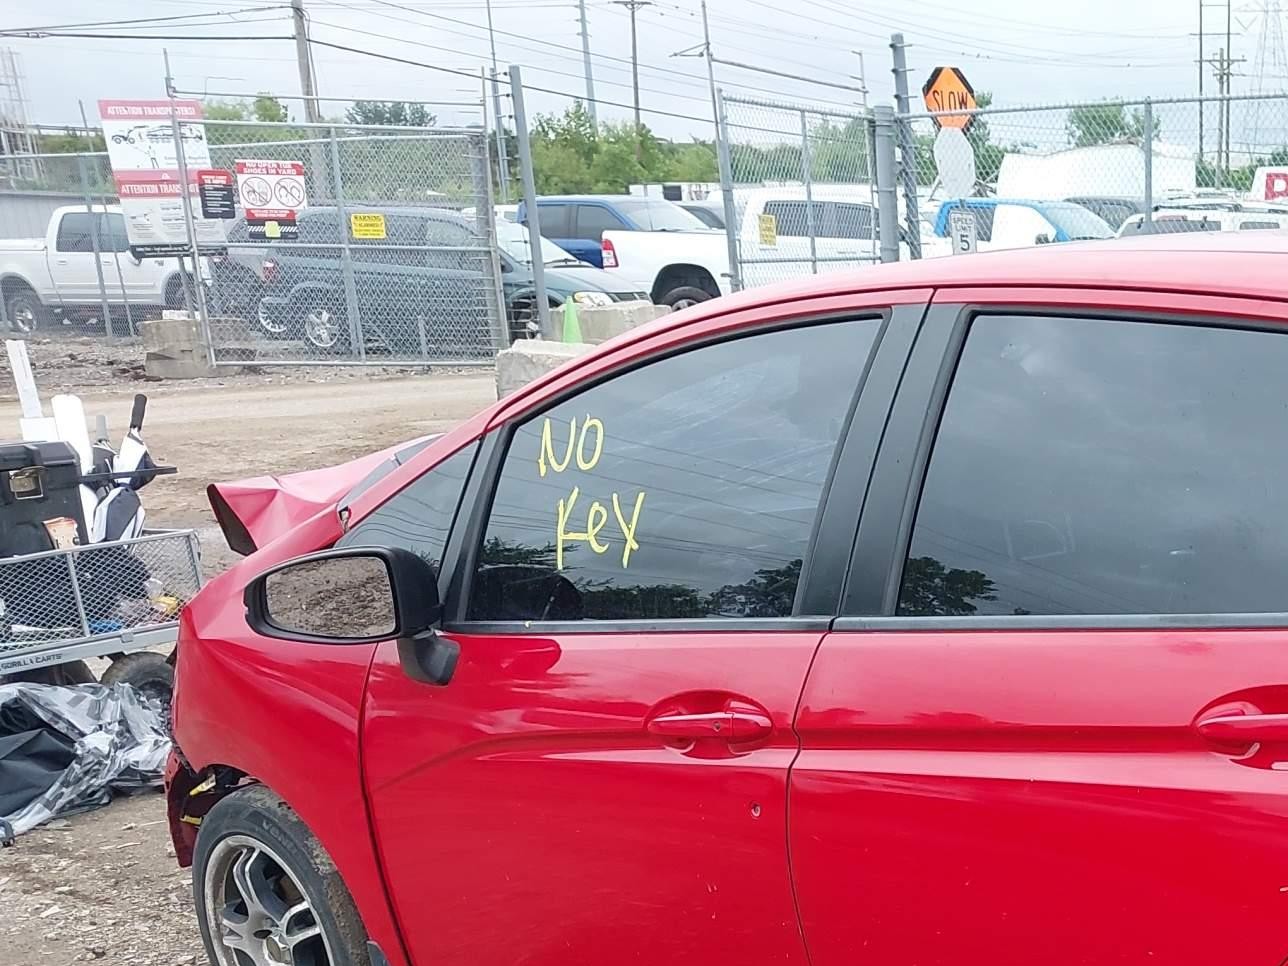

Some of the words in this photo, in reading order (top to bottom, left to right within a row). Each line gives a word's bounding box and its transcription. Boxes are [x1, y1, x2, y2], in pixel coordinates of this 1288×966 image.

[932, 89, 968, 112] SLOW
[121, 184, 159, 194] ATTENTION
[960, 233, 970, 252] 5
[538, 413, 604, 477] NO
[35, 654, 62, 663] CARTS
